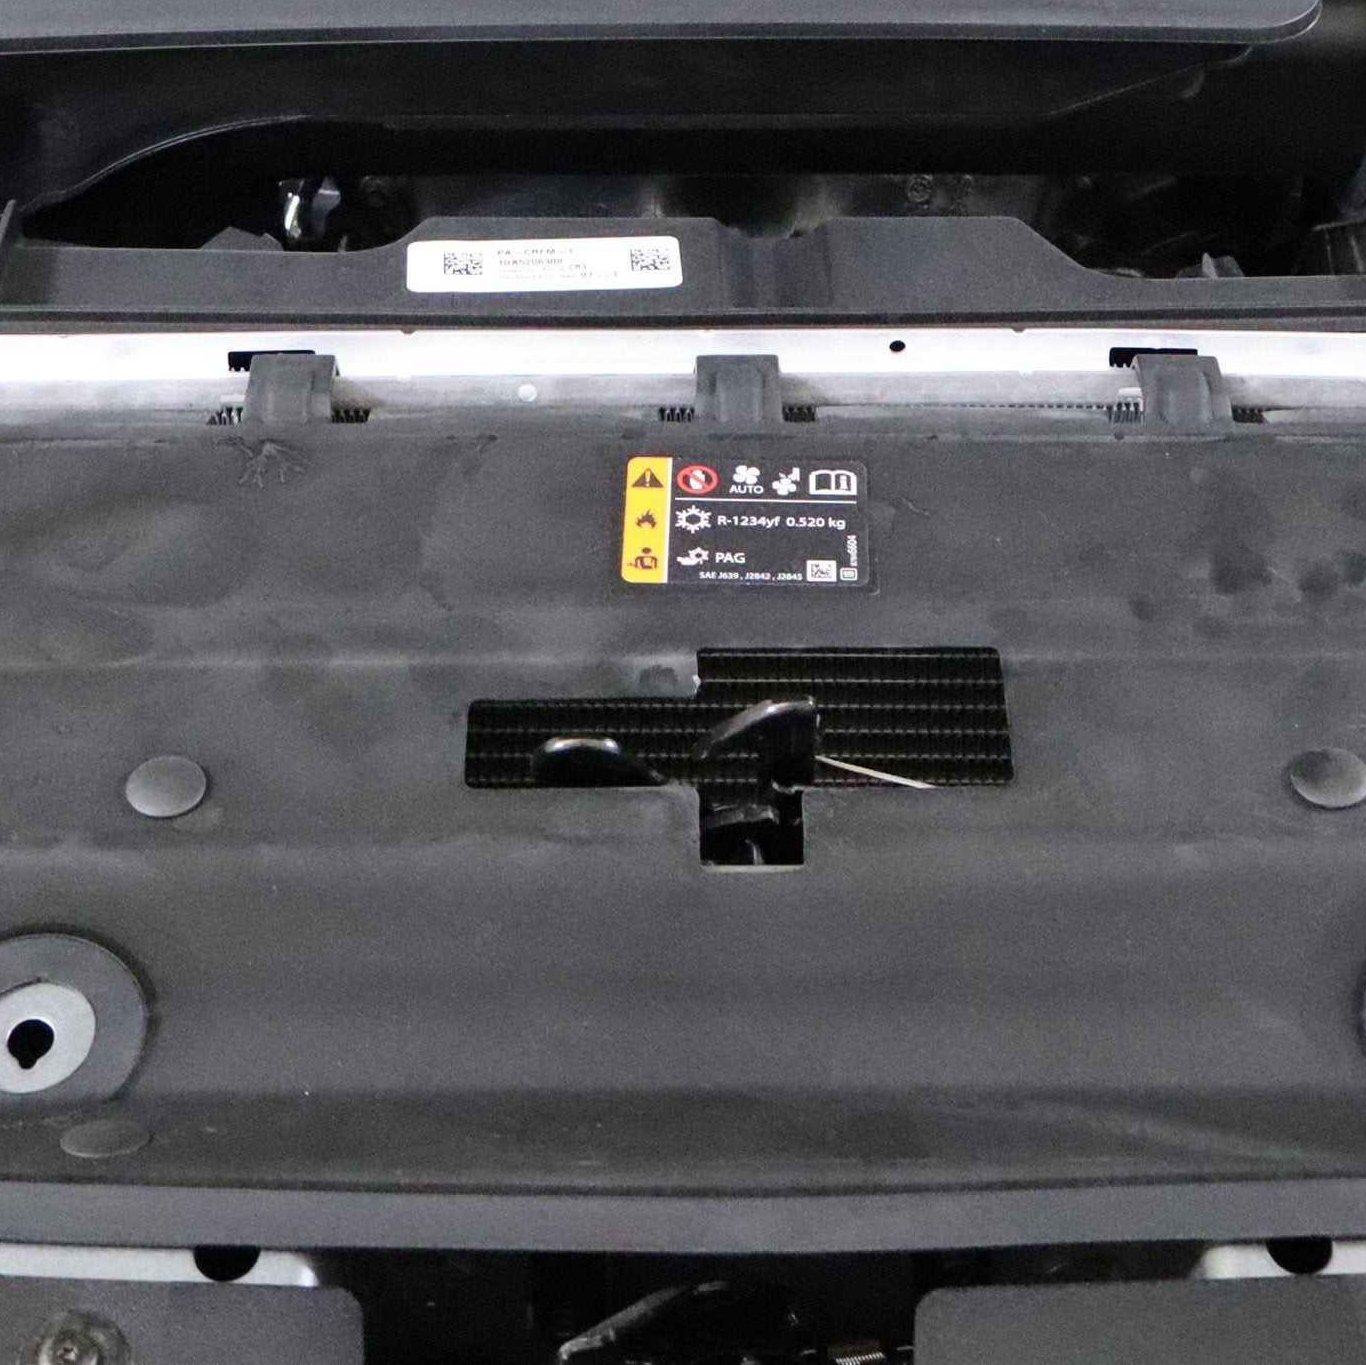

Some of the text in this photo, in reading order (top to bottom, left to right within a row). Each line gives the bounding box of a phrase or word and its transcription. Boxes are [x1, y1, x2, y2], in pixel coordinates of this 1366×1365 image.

[729, 484, 764, 494] AUTO
[717, 515, 847, 530] R-1234yf 0.520 kg
[715, 552, 746, 564] PAG
[699, 571, 716, 579] SAE
